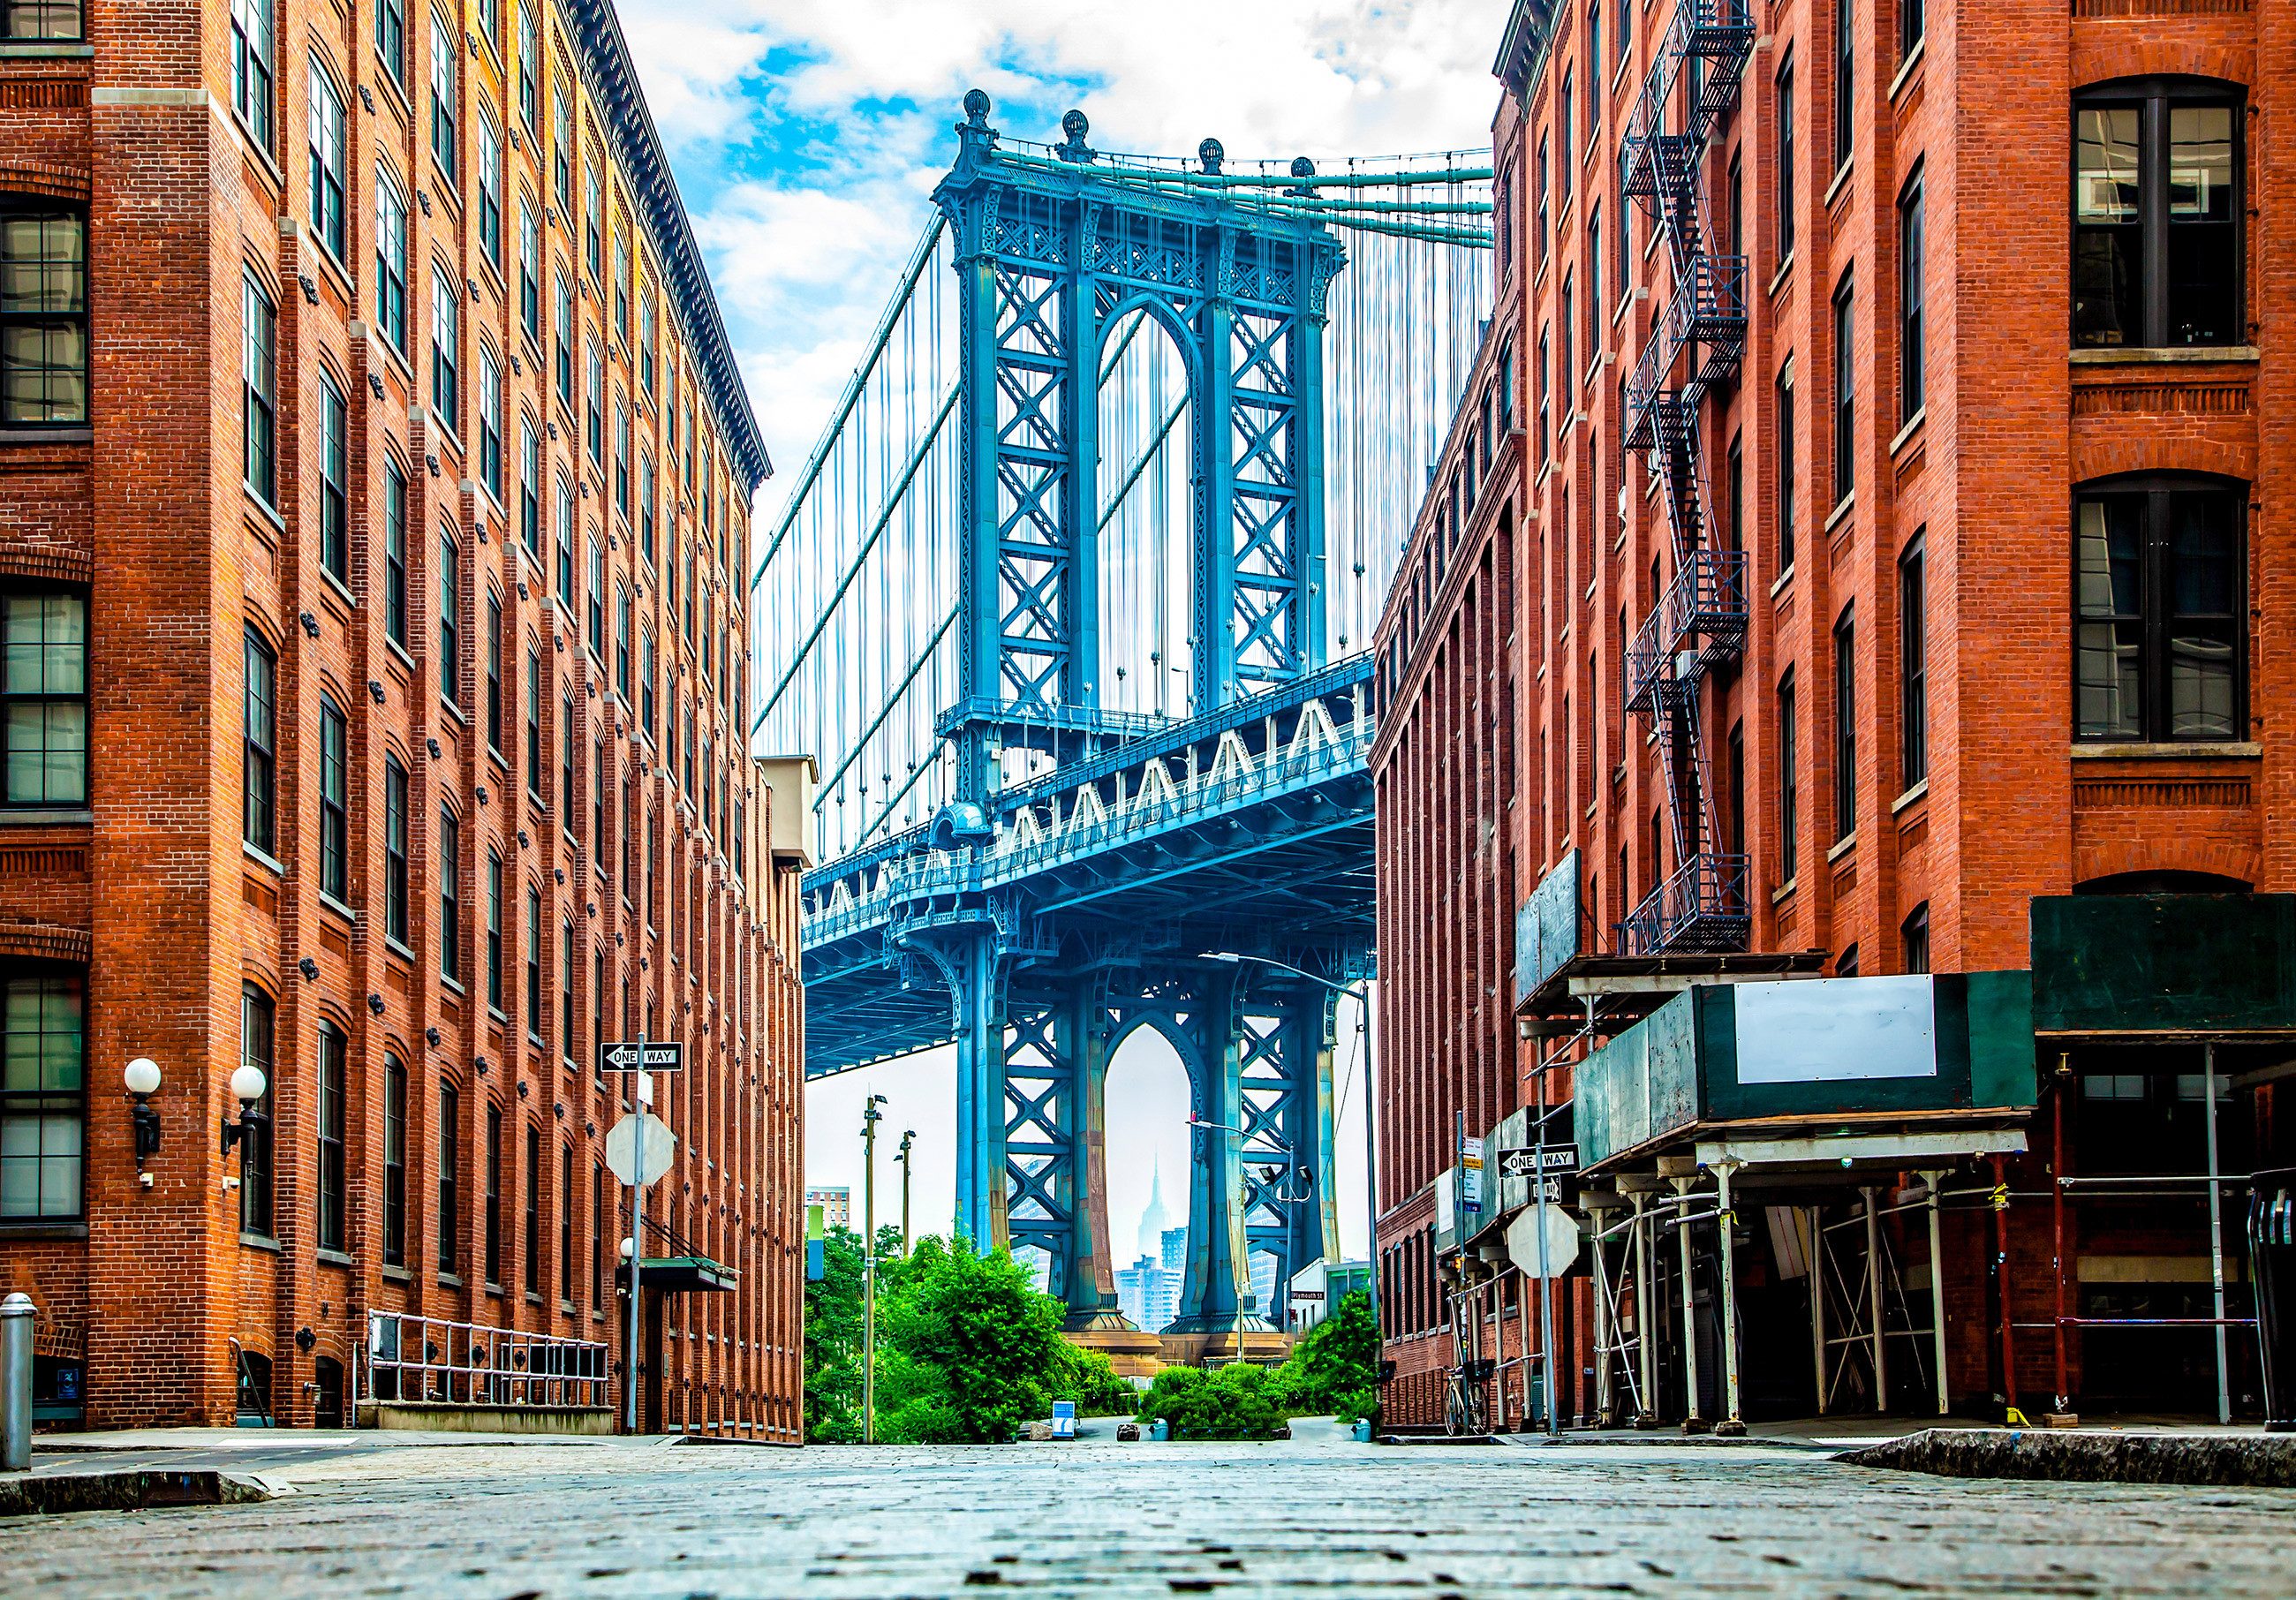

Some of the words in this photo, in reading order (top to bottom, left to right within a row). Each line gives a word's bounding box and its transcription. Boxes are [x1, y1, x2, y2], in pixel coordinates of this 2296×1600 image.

[614, 1052, 637, 1063] ONE
[647, 1051, 671, 1062] WAY
[1510, 1156, 1534, 1169] ONE
[1544, 1152, 1568, 1166] WAY
